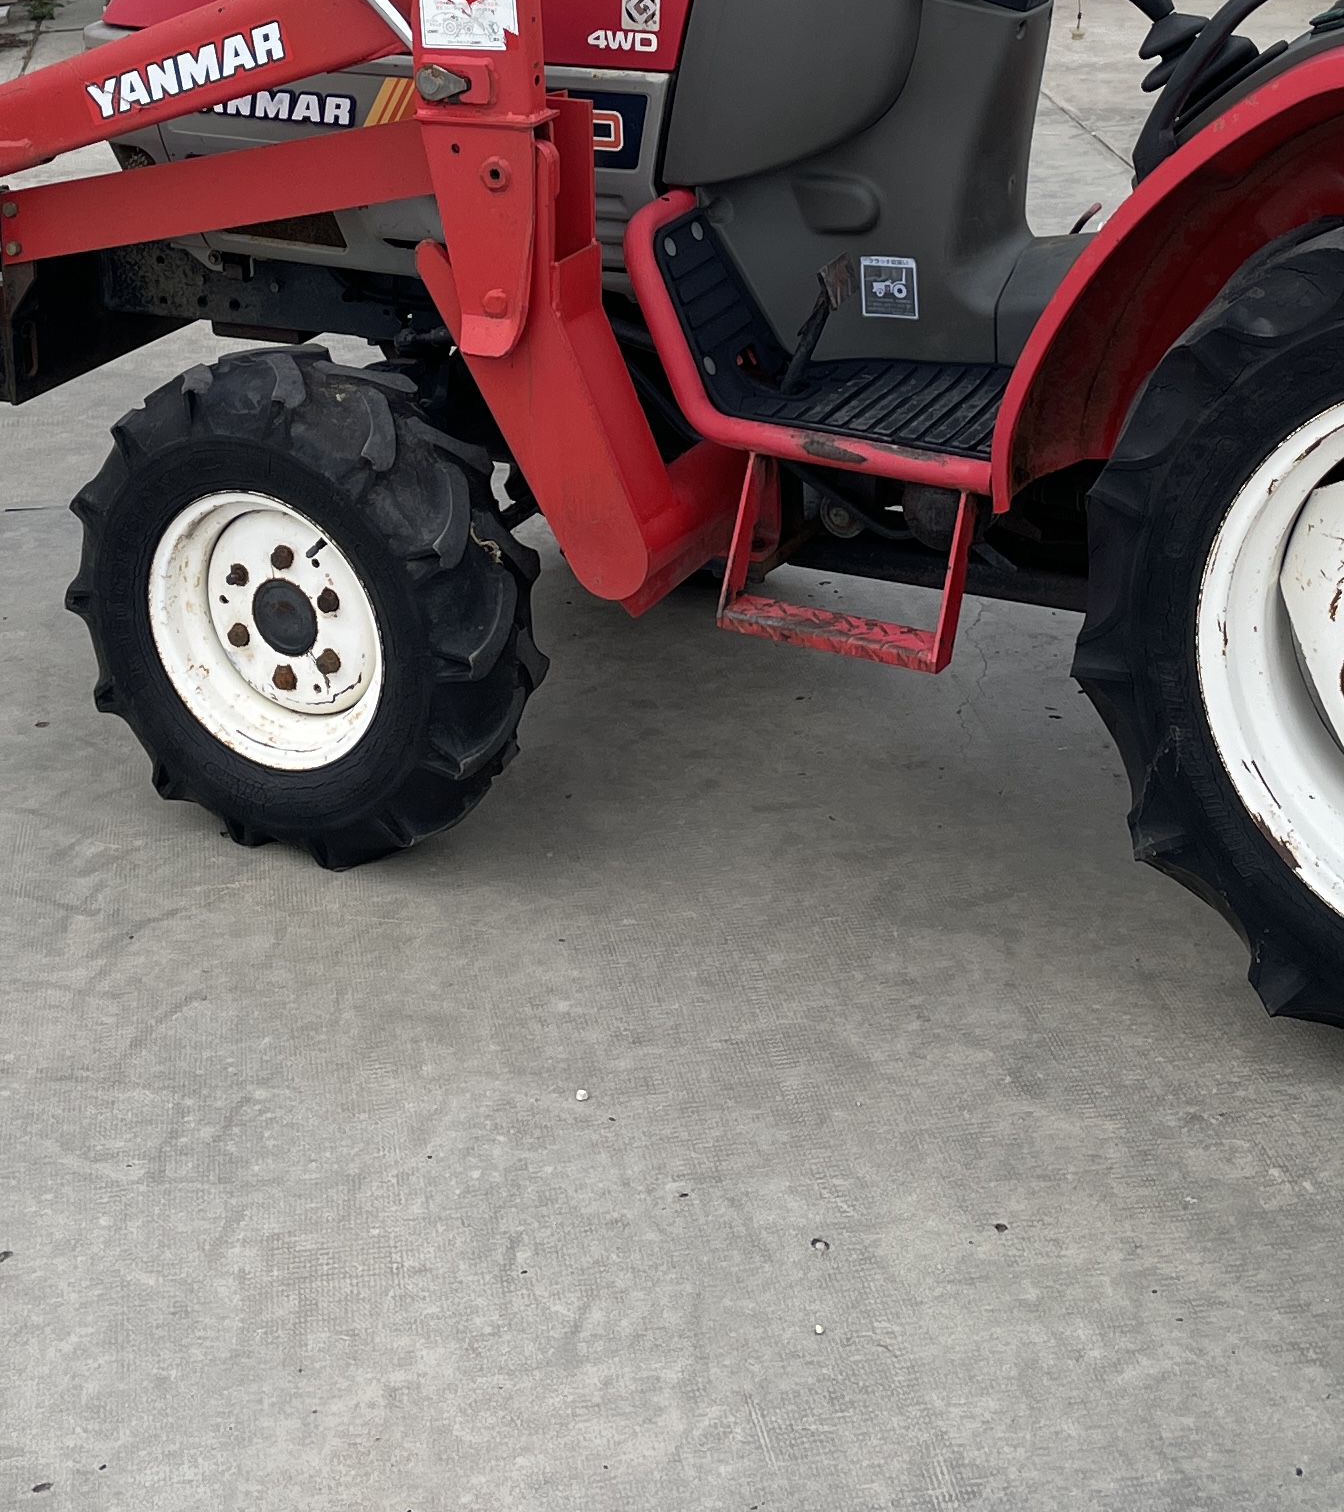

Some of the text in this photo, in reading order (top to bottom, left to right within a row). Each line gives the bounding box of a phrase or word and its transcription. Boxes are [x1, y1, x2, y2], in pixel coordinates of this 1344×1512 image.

[587, 29, 658, 53] 4WD
[86, 20, 286, 119] YANMAR
[202, 90, 352, 126] NMAR
